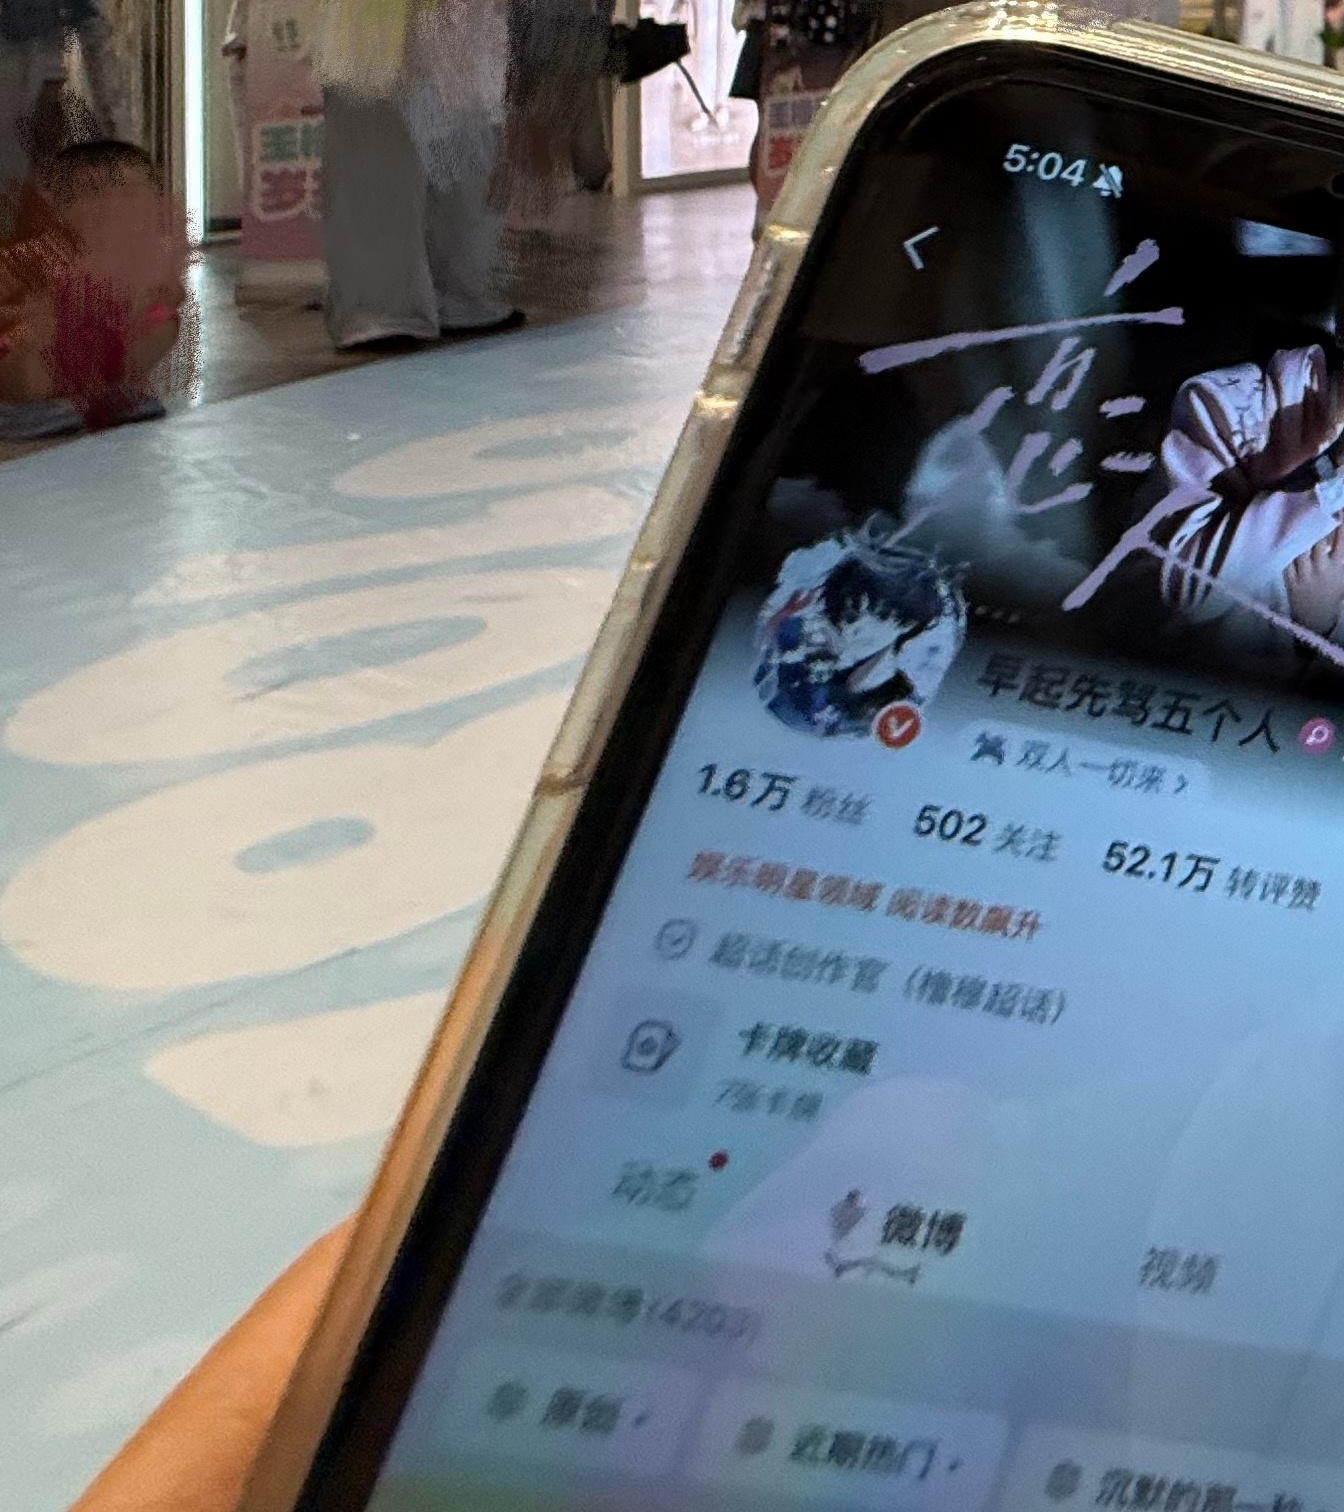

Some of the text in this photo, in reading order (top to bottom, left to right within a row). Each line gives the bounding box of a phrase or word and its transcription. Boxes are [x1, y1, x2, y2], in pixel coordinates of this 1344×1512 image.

[1002, 143, 1087, 187] 5:04
[697, 761, 798, 812] 1.6万
[914, 803, 990, 848] 502
[992, 820, 1062, 864] 关注
[1101, 838, 1222, 894] 52.1万
[1224, 863, 1324, 913] 转评赞
[1138, 1244, 1222, 1294] 视频
